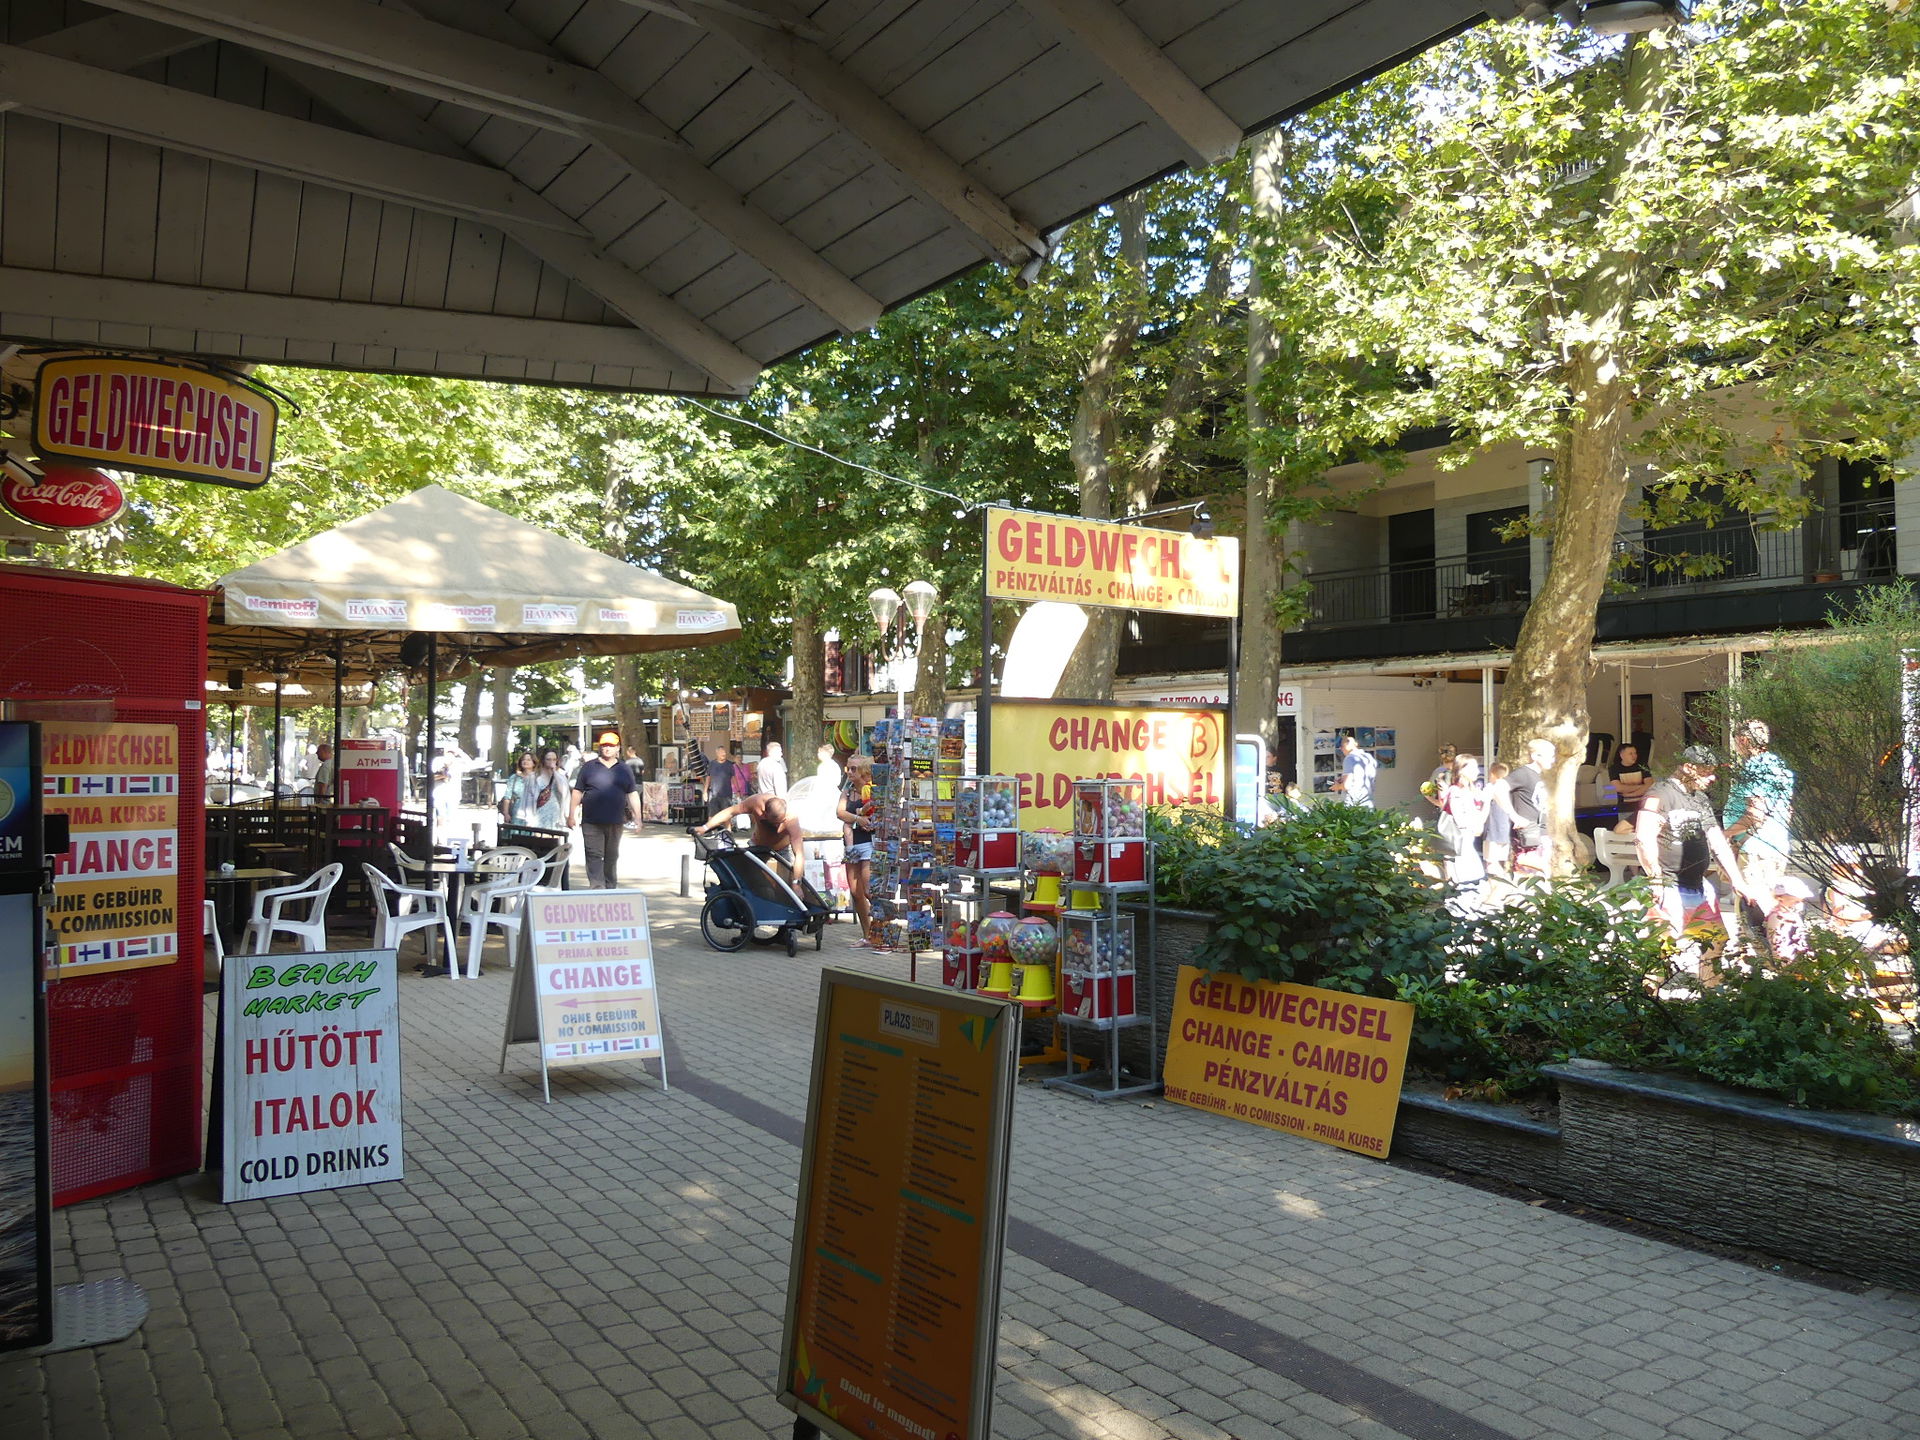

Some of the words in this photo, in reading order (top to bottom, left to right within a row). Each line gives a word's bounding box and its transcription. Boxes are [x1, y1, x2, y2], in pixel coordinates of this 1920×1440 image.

[49, 373, 263, 474] GELDWECHSEL
[997, 518, 1230, 584] GELDWECH
[996, 566, 1092, 597] PÉNZVÁLTÁS
[1107, 581, 1163, 603] CHANGE
[1177, 588, 1229, 609] CAMO
[349, 605, 406, 616] HAVANNA
[525, 609, 576, 621] HAVANNA
[1049, 716, 1167, 752] CHANGE
[356, 758, 380, 767] ATM
[110, 805, 167, 824] KURSE
[55, 836, 173, 875] HANGE
[92, 886, 163, 910] GEBÜHR
[543, 902, 635, 925] GELDWECHSEL
[61, 908, 173, 934] COMMISSION
[558, 948, 593, 959] PRIMA
[596, 946, 630, 957] KURSE
[246, 961, 378, 990] BEACH
[550, 964, 643, 990] CHANGE
[243, 987, 381, 1018] MARKET
[1189, 977, 1392, 1043] GELDWECHSEL
[558, 1027, 574, 1037] NO
[578, 1020, 646, 1036] COMMISSION
[562, 1012, 592, 1025] OHNE
[246, 1025, 383, 1075] HŰTÖTT
[1182, 1018, 1273, 1059] CHANGE
[1292, 1041, 1389, 1084] CAMBIO
[1203, 1058, 1349, 1116] PÉNZVÁLTÁS
[254, 1088, 378, 1137] ITALOK
[1164, 1084, 1188, 1101] OHNE
[1233, 1102, 1248, 1116] NO
[1249, 1106, 1305, 1132] COMISSION
[1313, 1122, 1345, 1143] PRIMA
[1347, 1131, 1384, 1153] KURSE
[240, 1155, 299, 1184] COLD
[306, 1144, 390, 1176] DRINKS
